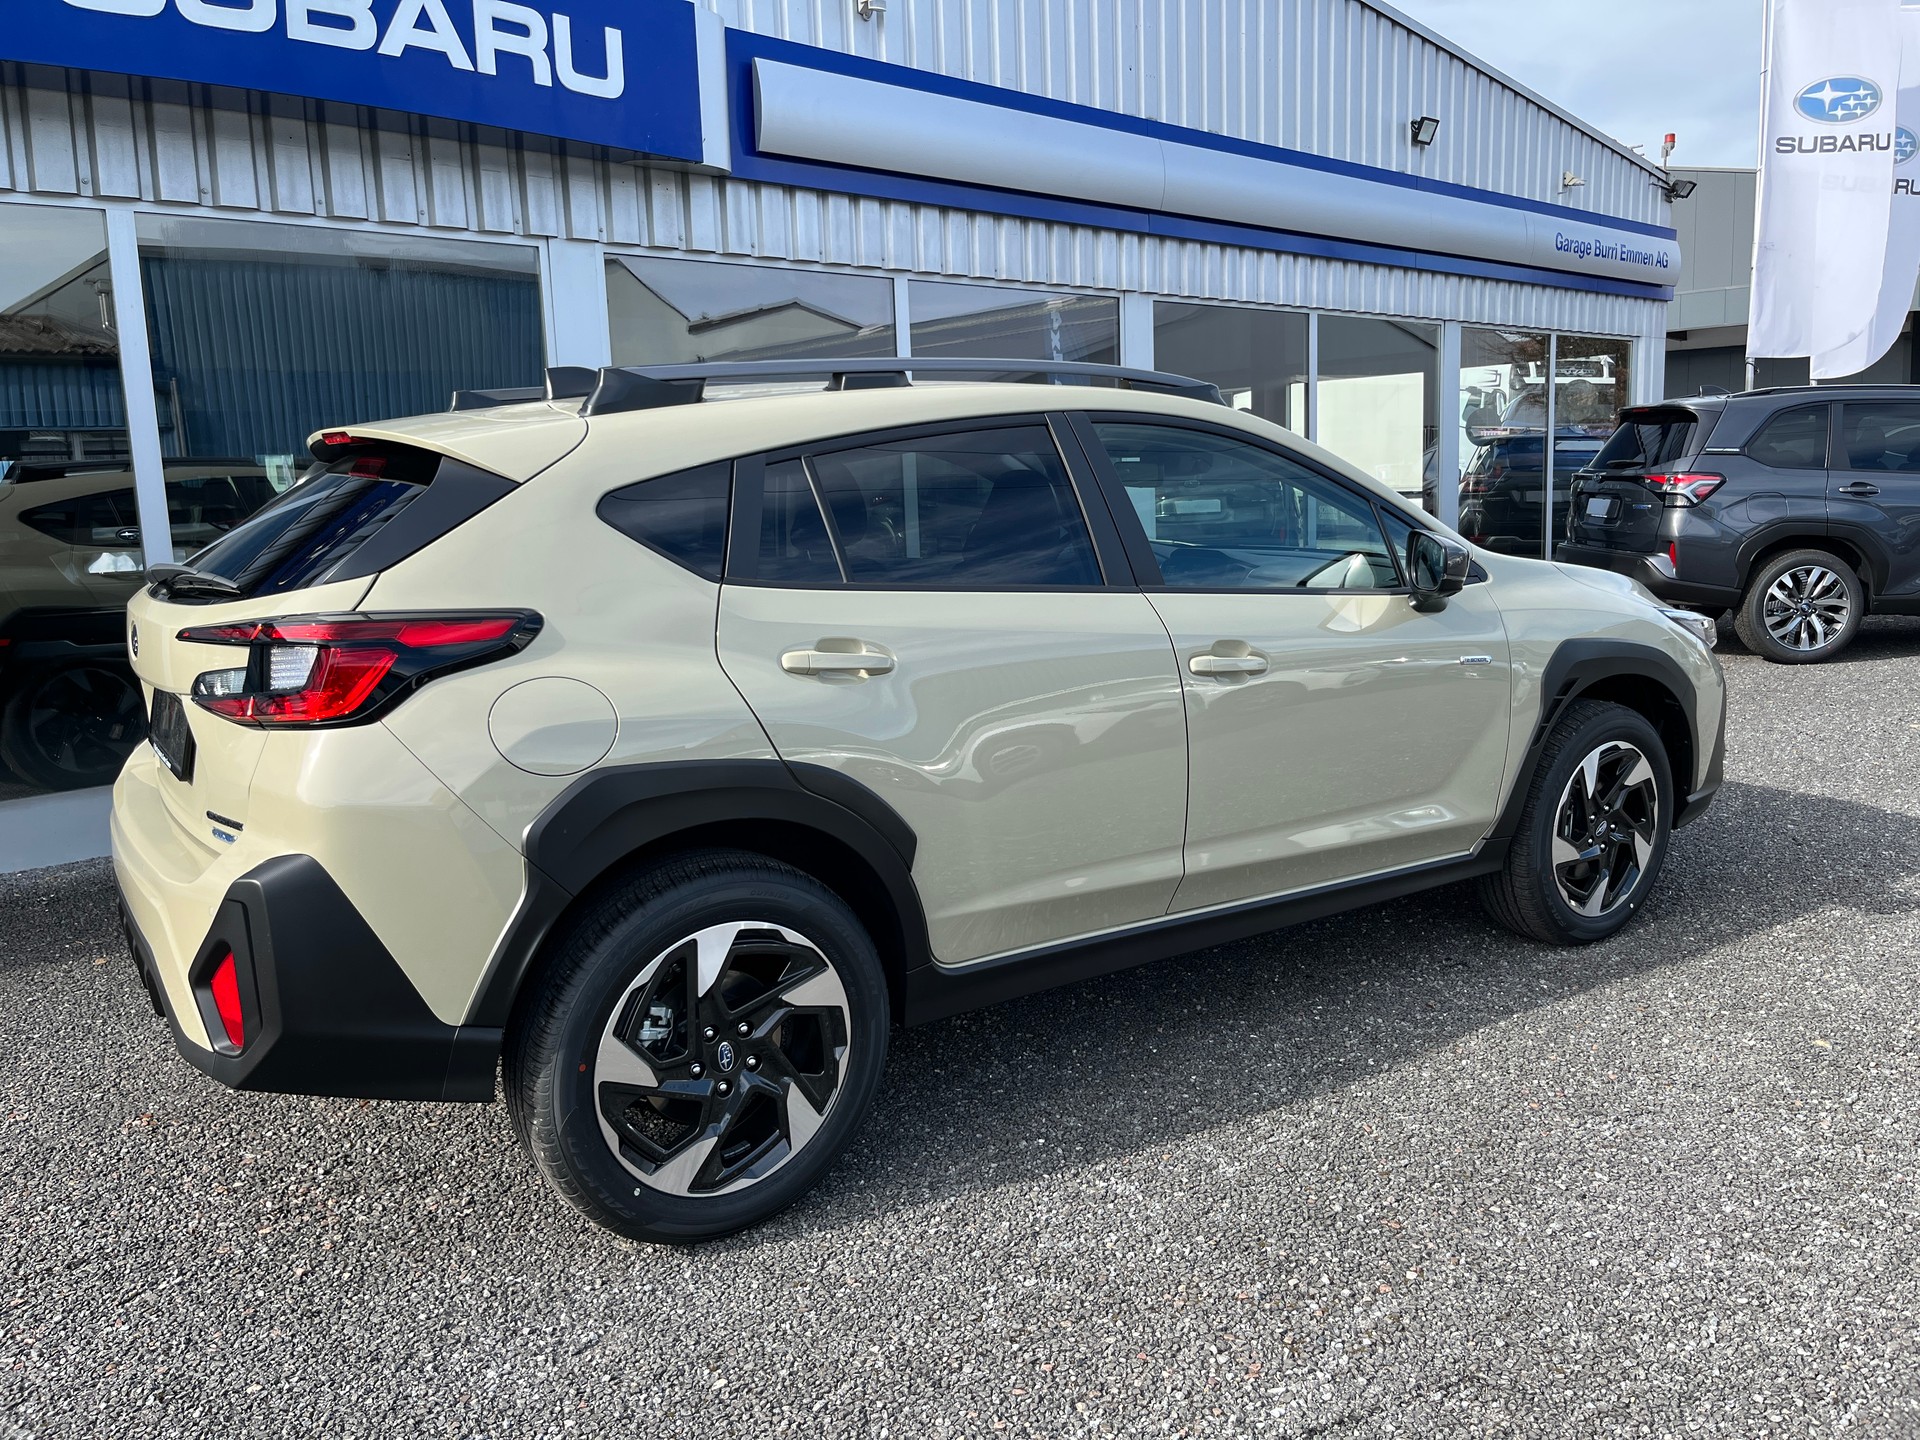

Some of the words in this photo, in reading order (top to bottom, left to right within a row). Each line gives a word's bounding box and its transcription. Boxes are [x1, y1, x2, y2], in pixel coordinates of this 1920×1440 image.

[60, 0, 626, 99] BARU
[1775, 133, 1892, 154] SUBARU
[1555, 232, 1592, 259] Garage
[1594, 239, 1618, 260] Burri
[1620, 243, 1654, 266] Emmen
[1655, 250, 1669, 269] AG
